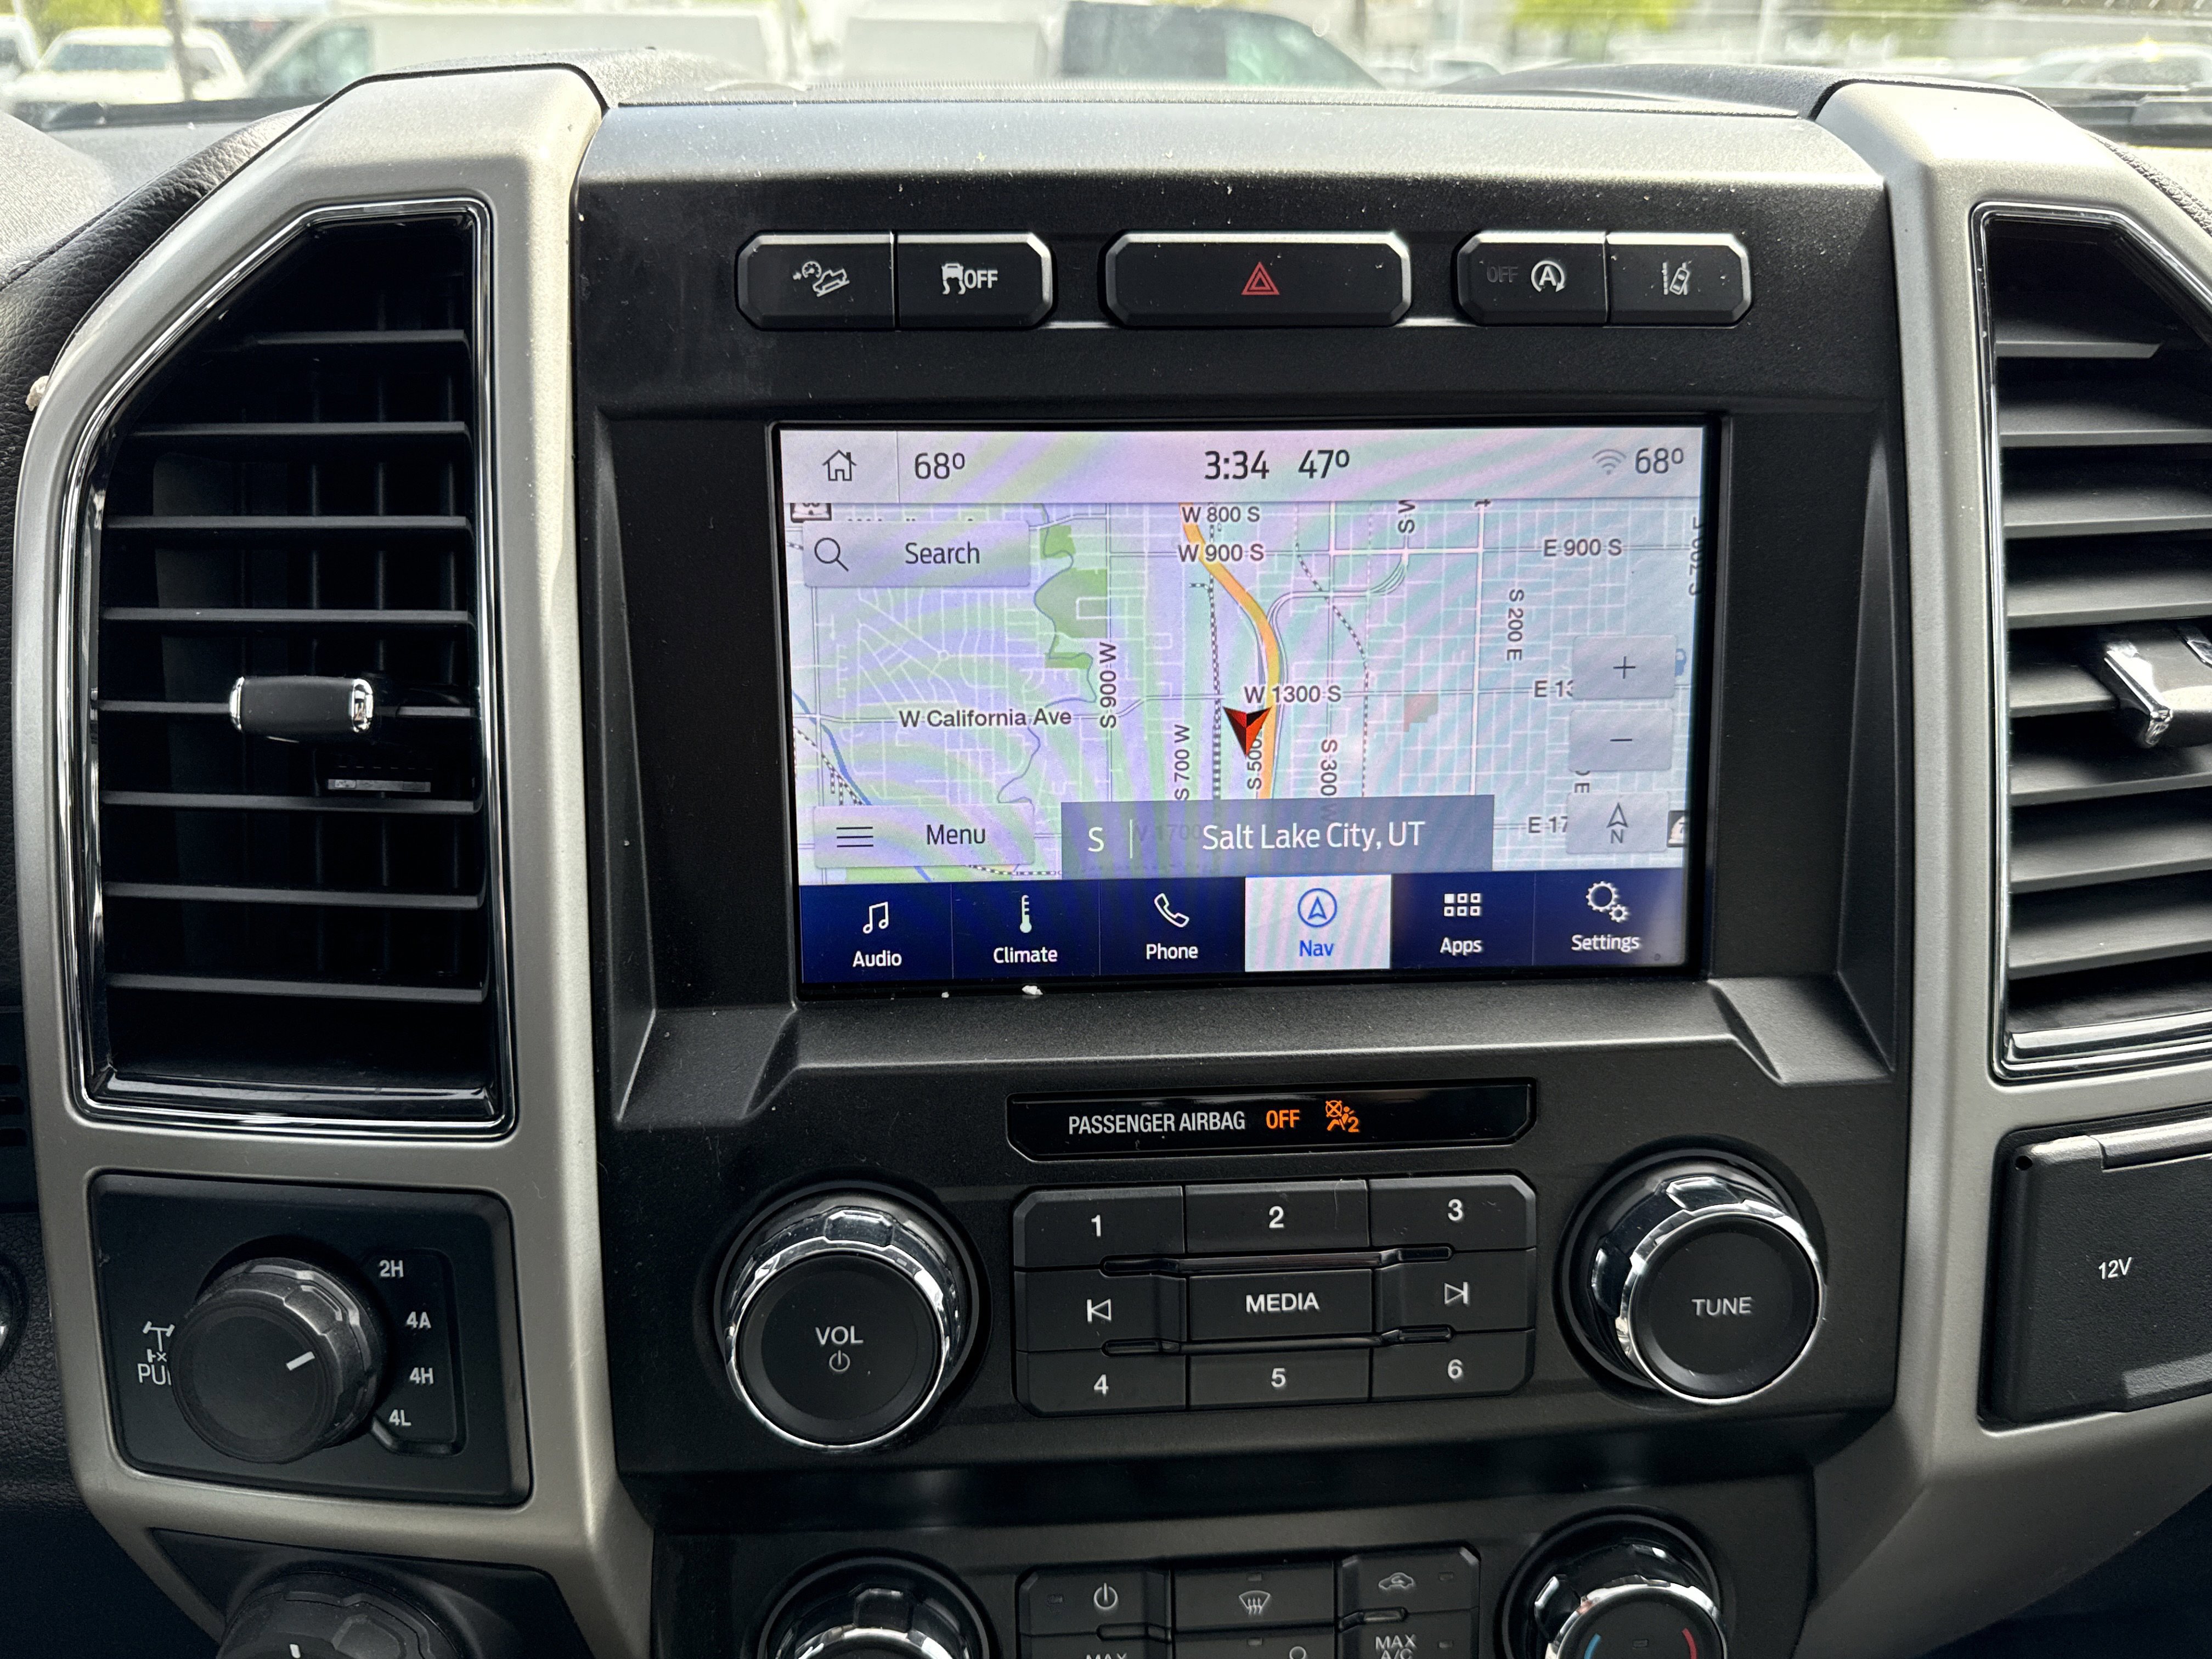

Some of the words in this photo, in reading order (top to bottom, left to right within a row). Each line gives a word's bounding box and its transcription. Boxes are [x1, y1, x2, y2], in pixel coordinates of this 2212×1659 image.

[964, 270, 998, 289] OFF
[1486, 266, 1519, 283] OFF
[1204, 450, 1269, 479] 3:34
[1182, 506, 1201, 523] W
[1206, 506, 1242, 523] 800
[1246, 506, 1260, 523] S
[905, 541, 980, 565] Search
[1178, 544, 1199, 562] W
[1205, 544, 1243, 562] 900
[1250, 544, 1265, 562] S
[1544, 539, 1557, 557] E
[1564, 539, 1601, 556] 900
[1607, 539, 1622, 556] S
[1509, 589, 1525, 602] S
[1508, 607, 1524, 642] 200
[1099, 641, 1117, 664] W
[1506, 648, 1522, 661] E
[1099, 670, 1117, 708] 900
[1244, 686, 1266, 703] W
[1272, 685, 1321, 703] 1300
[1328, 685, 1342, 703] S
[1534, 680, 1548, 698] E
[899, 710, 921, 727] W
[926, 708, 1027, 727] California
[1032, 708, 1072, 726] Ave
[1099, 715, 1117, 729] S
[1173, 724, 1190, 743] W
[1321, 738, 1338, 754] S
[1173, 748, 1190, 783] 700
[1247, 777, 1262, 791] S
[1320, 759, 1338, 797] 300
[1174, 787, 1190, 800] S
[926, 824, 986, 845] Menu
[1528, 816, 1542, 834] E
[1087, 827, 1104, 852] S
[1202, 823, 1254, 850] Salt
[1261, 822, 1320, 849] Lake
[1327, 822, 1381, 852] City,
[1389, 821, 1426, 847] UT
[1610, 829, 1624, 844] N
[1146, 943, 1198, 960] Phone
[1300, 939, 1334, 957] Nav
[1440, 937, 1482, 956] Apps
[1571, 934, 1640, 952] Settings
[853, 950, 902, 967] Audio
[993, 946, 1058, 964] Climate
[1069, 1113, 1175, 1135] PASSENGER
[1178, 1111, 1245, 1131] AIRBAG
[1266, 1109, 1300, 1129] OFF
[1269, 1206, 1284, 1228] 2
[1448, 1199, 1464, 1221] 3
[1091, 1215, 1102, 1237] 1
[380, 1260, 404, 1278] 2H
[2098, 1257, 2132, 1280] 12V
[1246, 1292, 1320, 1313] MEDIA
[1691, 1296, 1753, 1316] TUNE
[406, 1312, 431, 1329] 4A
[815, 1325, 864, 1345] VOL
[409, 1367, 433, 1385] 4H
[1271, 1368, 1286, 1388] 5
[1447, 1359, 1463, 1379] 6
[1093, 1375, 1109, 1395] 4
[389, 1409, 411, 1426] 4L
[1375, 1634, 1417, 1650] MAX
